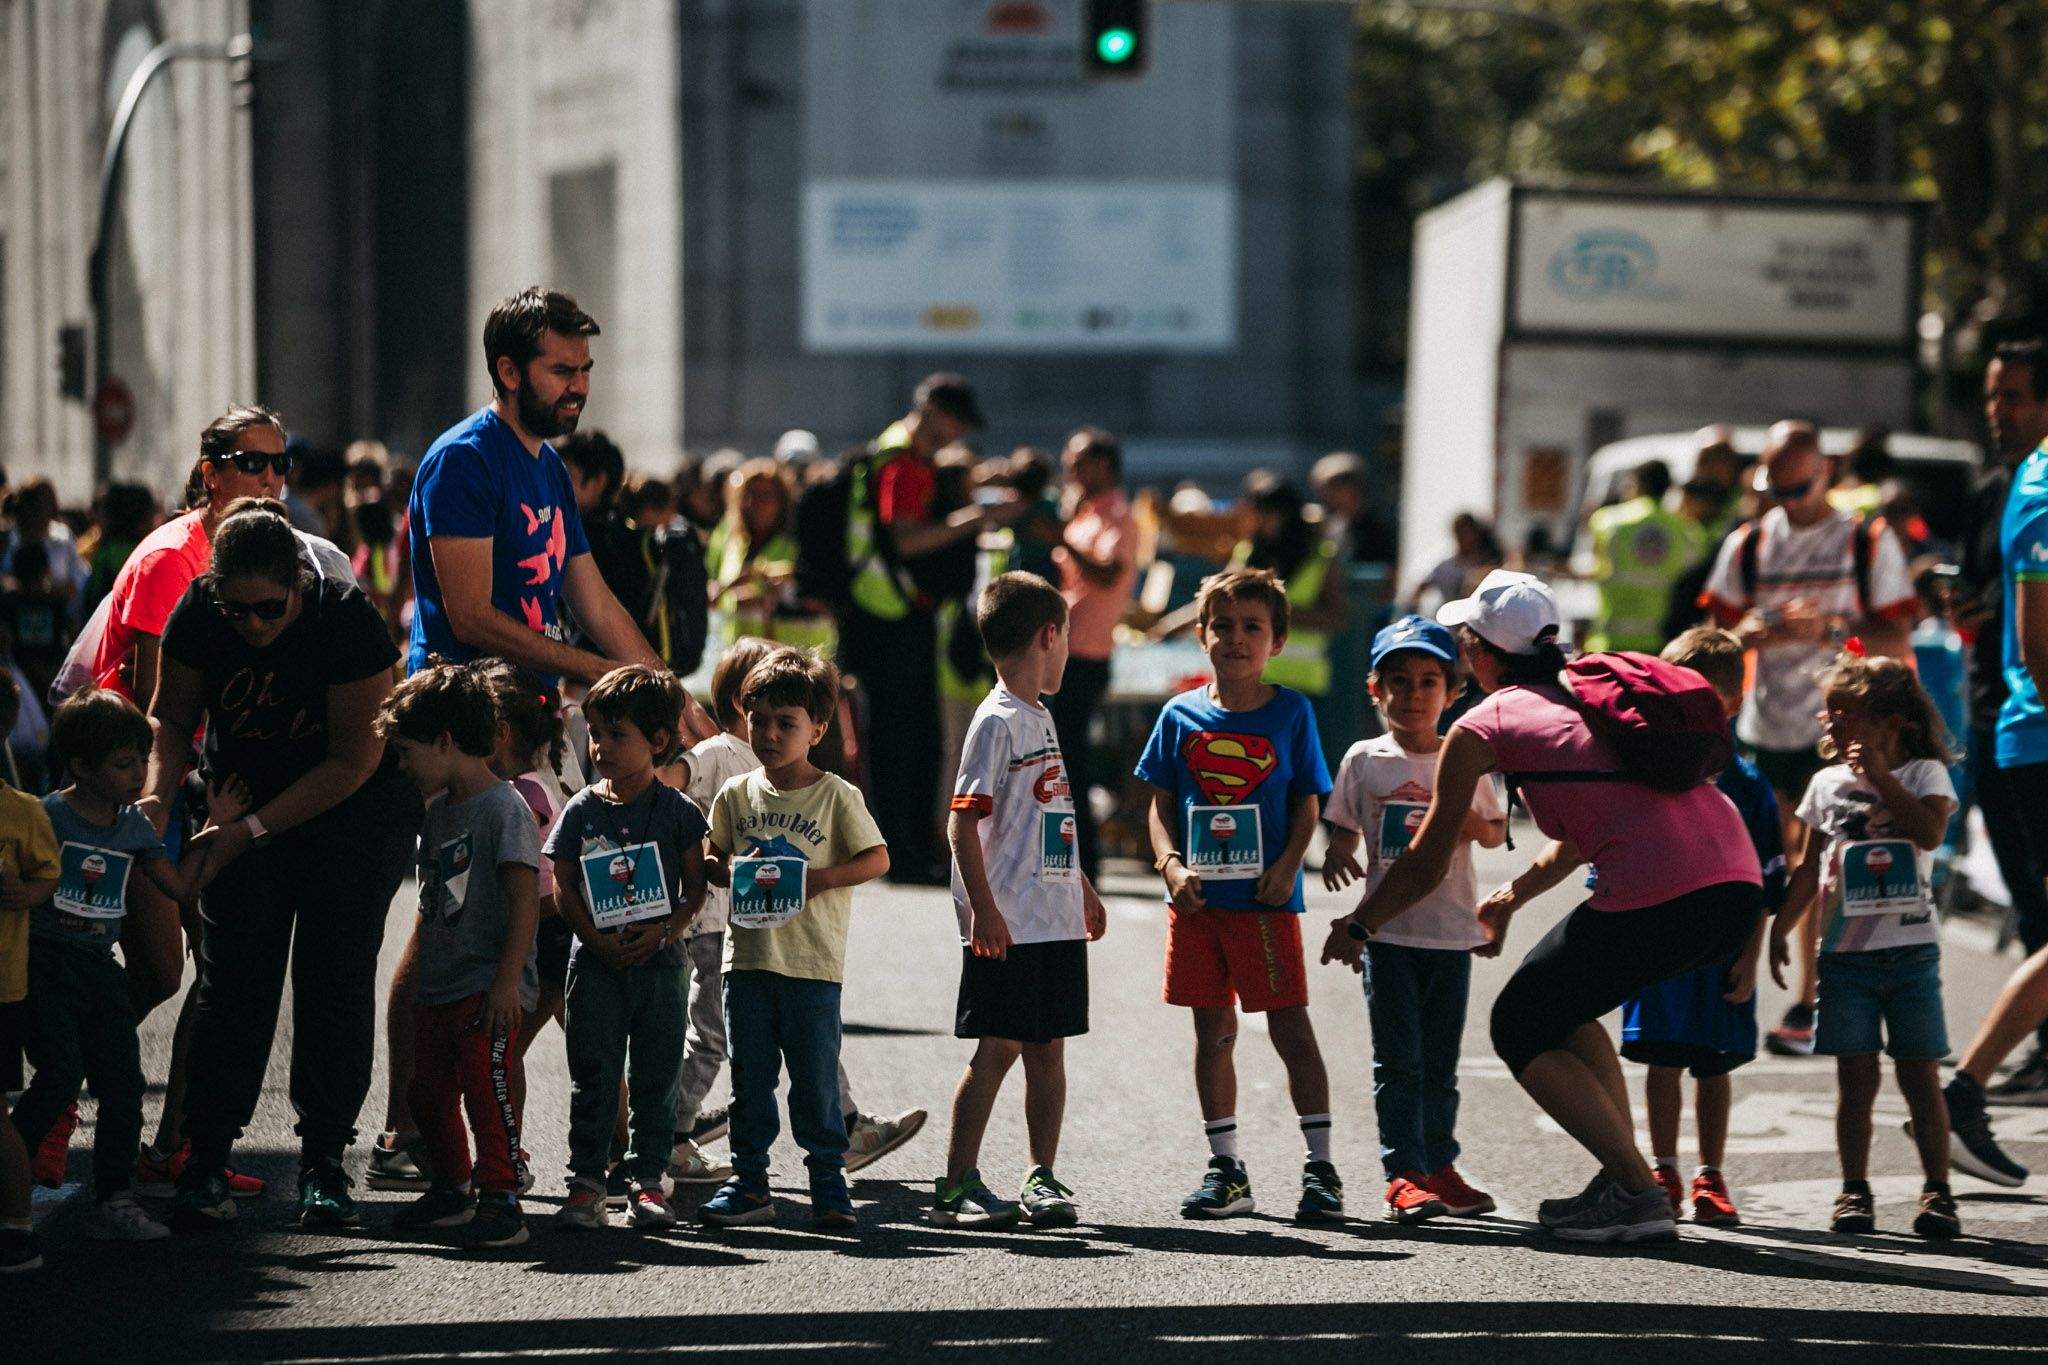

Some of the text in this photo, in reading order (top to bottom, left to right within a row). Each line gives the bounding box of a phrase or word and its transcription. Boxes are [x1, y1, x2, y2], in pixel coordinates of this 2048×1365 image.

[221, 666, 286, 711] Oh
[758, 812, 792, 832] you
[790, 812, 827, 847] later
